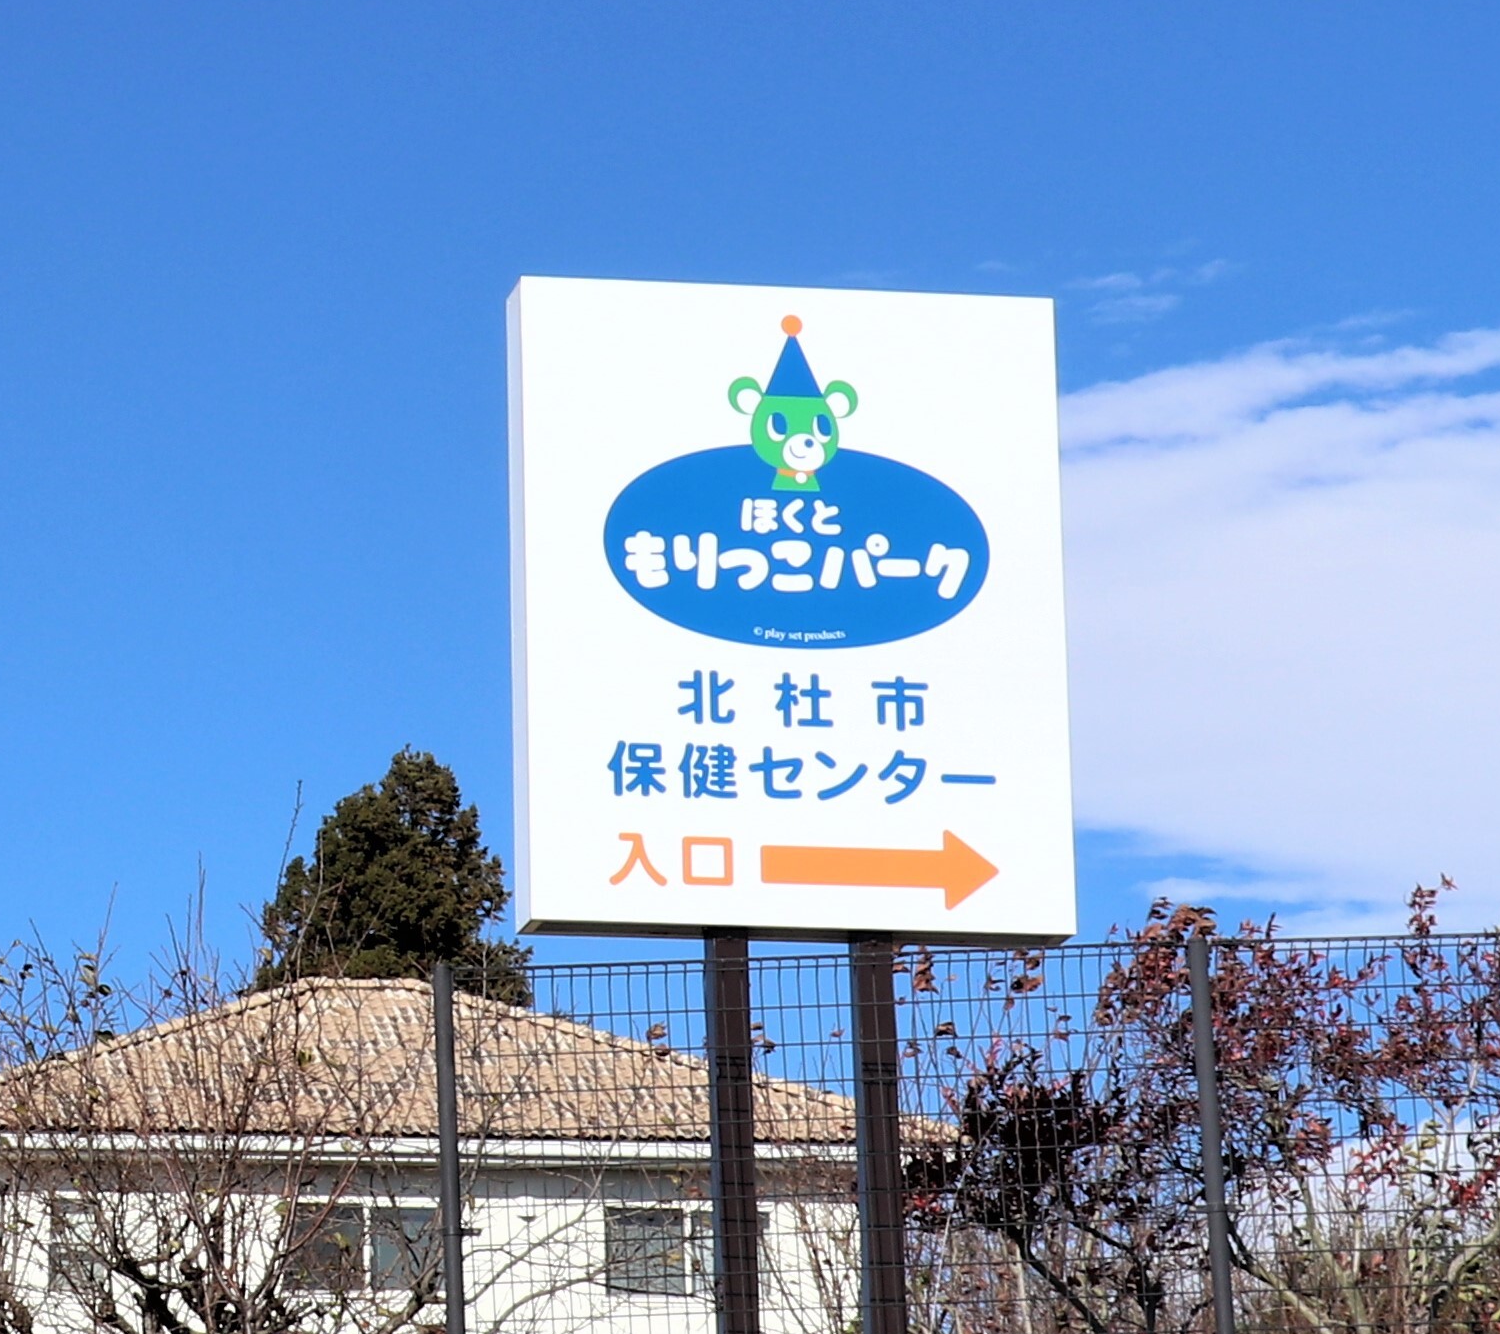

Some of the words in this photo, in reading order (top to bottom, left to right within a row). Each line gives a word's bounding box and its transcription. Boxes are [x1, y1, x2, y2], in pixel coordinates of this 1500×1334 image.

[740, 498, 842, 535] ほくと
[764, 627, 787, 642] play
[788, 631, 803, 641] set
[804, 630, 847, 643] products
[677, 669, 929, 732] 北杜市
[606, 740, 997, 805] 保健センター
[609, 832, 734, 887] 入口
